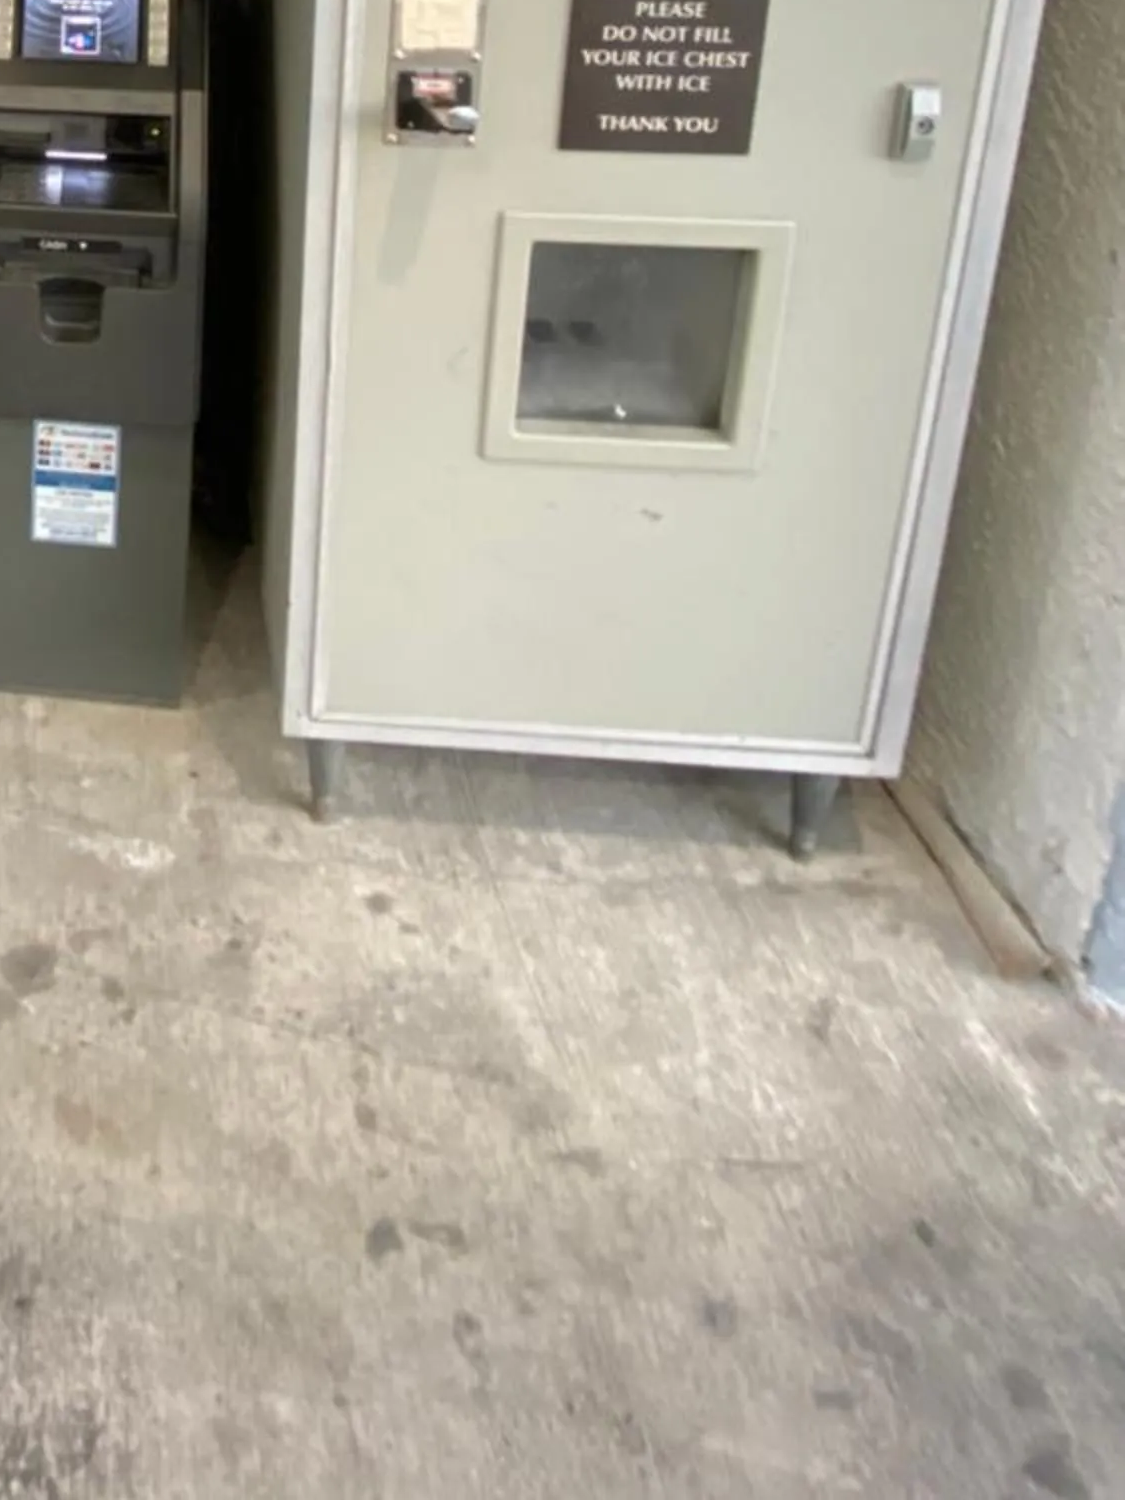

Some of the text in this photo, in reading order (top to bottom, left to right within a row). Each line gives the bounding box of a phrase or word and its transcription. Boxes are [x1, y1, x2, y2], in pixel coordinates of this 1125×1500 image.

[634, 1, 707, 19] PLEASE
[602, 25, 733, 44] DO NOT FILL
[581, 49, 751, 68] YOUR ICE CHEST
[616, 74, 712, 92] WITH ICE
[598, 114, 719, 133] THANK YOU
